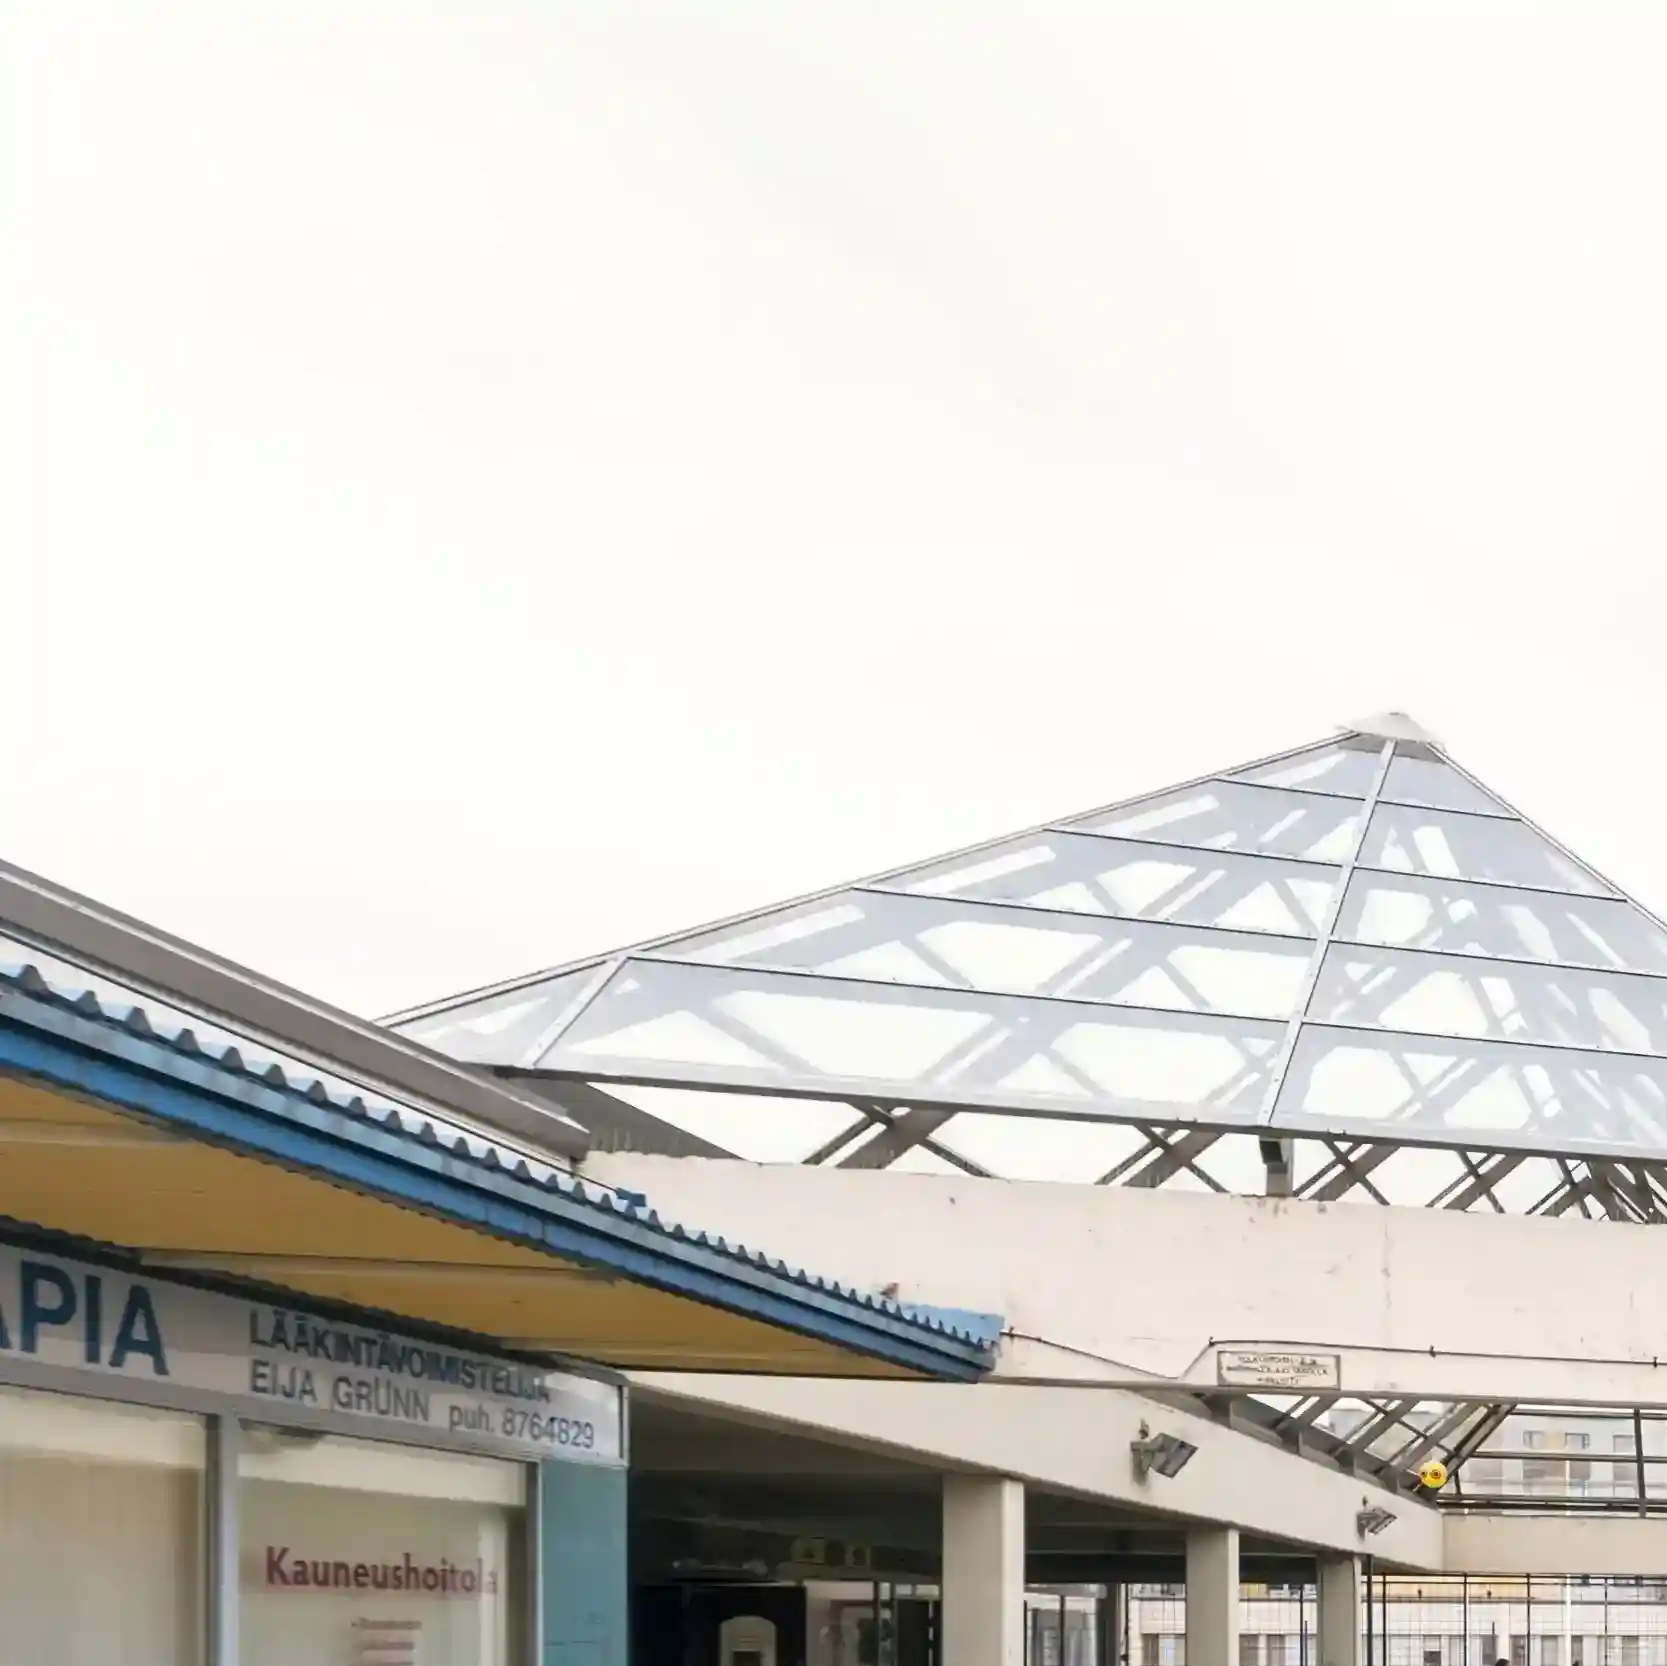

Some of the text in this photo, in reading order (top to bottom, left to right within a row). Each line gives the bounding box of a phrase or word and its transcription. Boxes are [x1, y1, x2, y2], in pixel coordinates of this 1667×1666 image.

[0, 1259, 169, 1376] PIA
[251, 1359, 318, 1402] EIJA
[447, 1403, 494, 1434] puh.
[264, 1545, 498, 1595] Kauneushoitola
